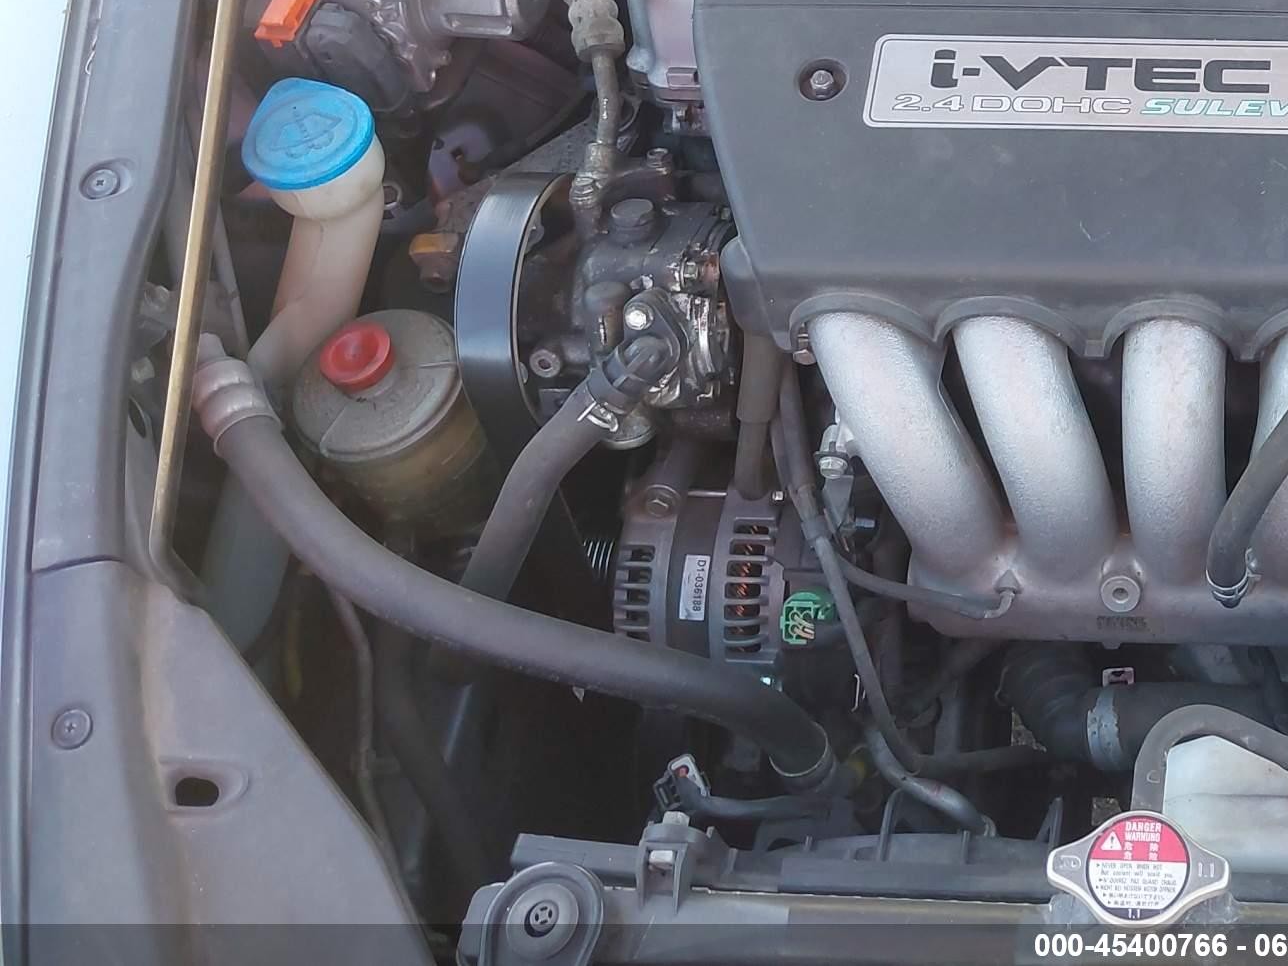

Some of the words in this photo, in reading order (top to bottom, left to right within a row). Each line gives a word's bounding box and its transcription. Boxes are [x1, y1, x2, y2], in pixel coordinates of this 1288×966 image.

[929, 49, 1271, 94] i-VTEC
[892, 94, 964, 111] 2.4
[972, 95, 1132, 115] DOHC
[692, 560, 707, 612] D1-036188
[1125, 821, 1162, 832] DANGER
[1198, 862, 1215, 878] 1.1
[1128, 908, 1141, 919] 1.1
